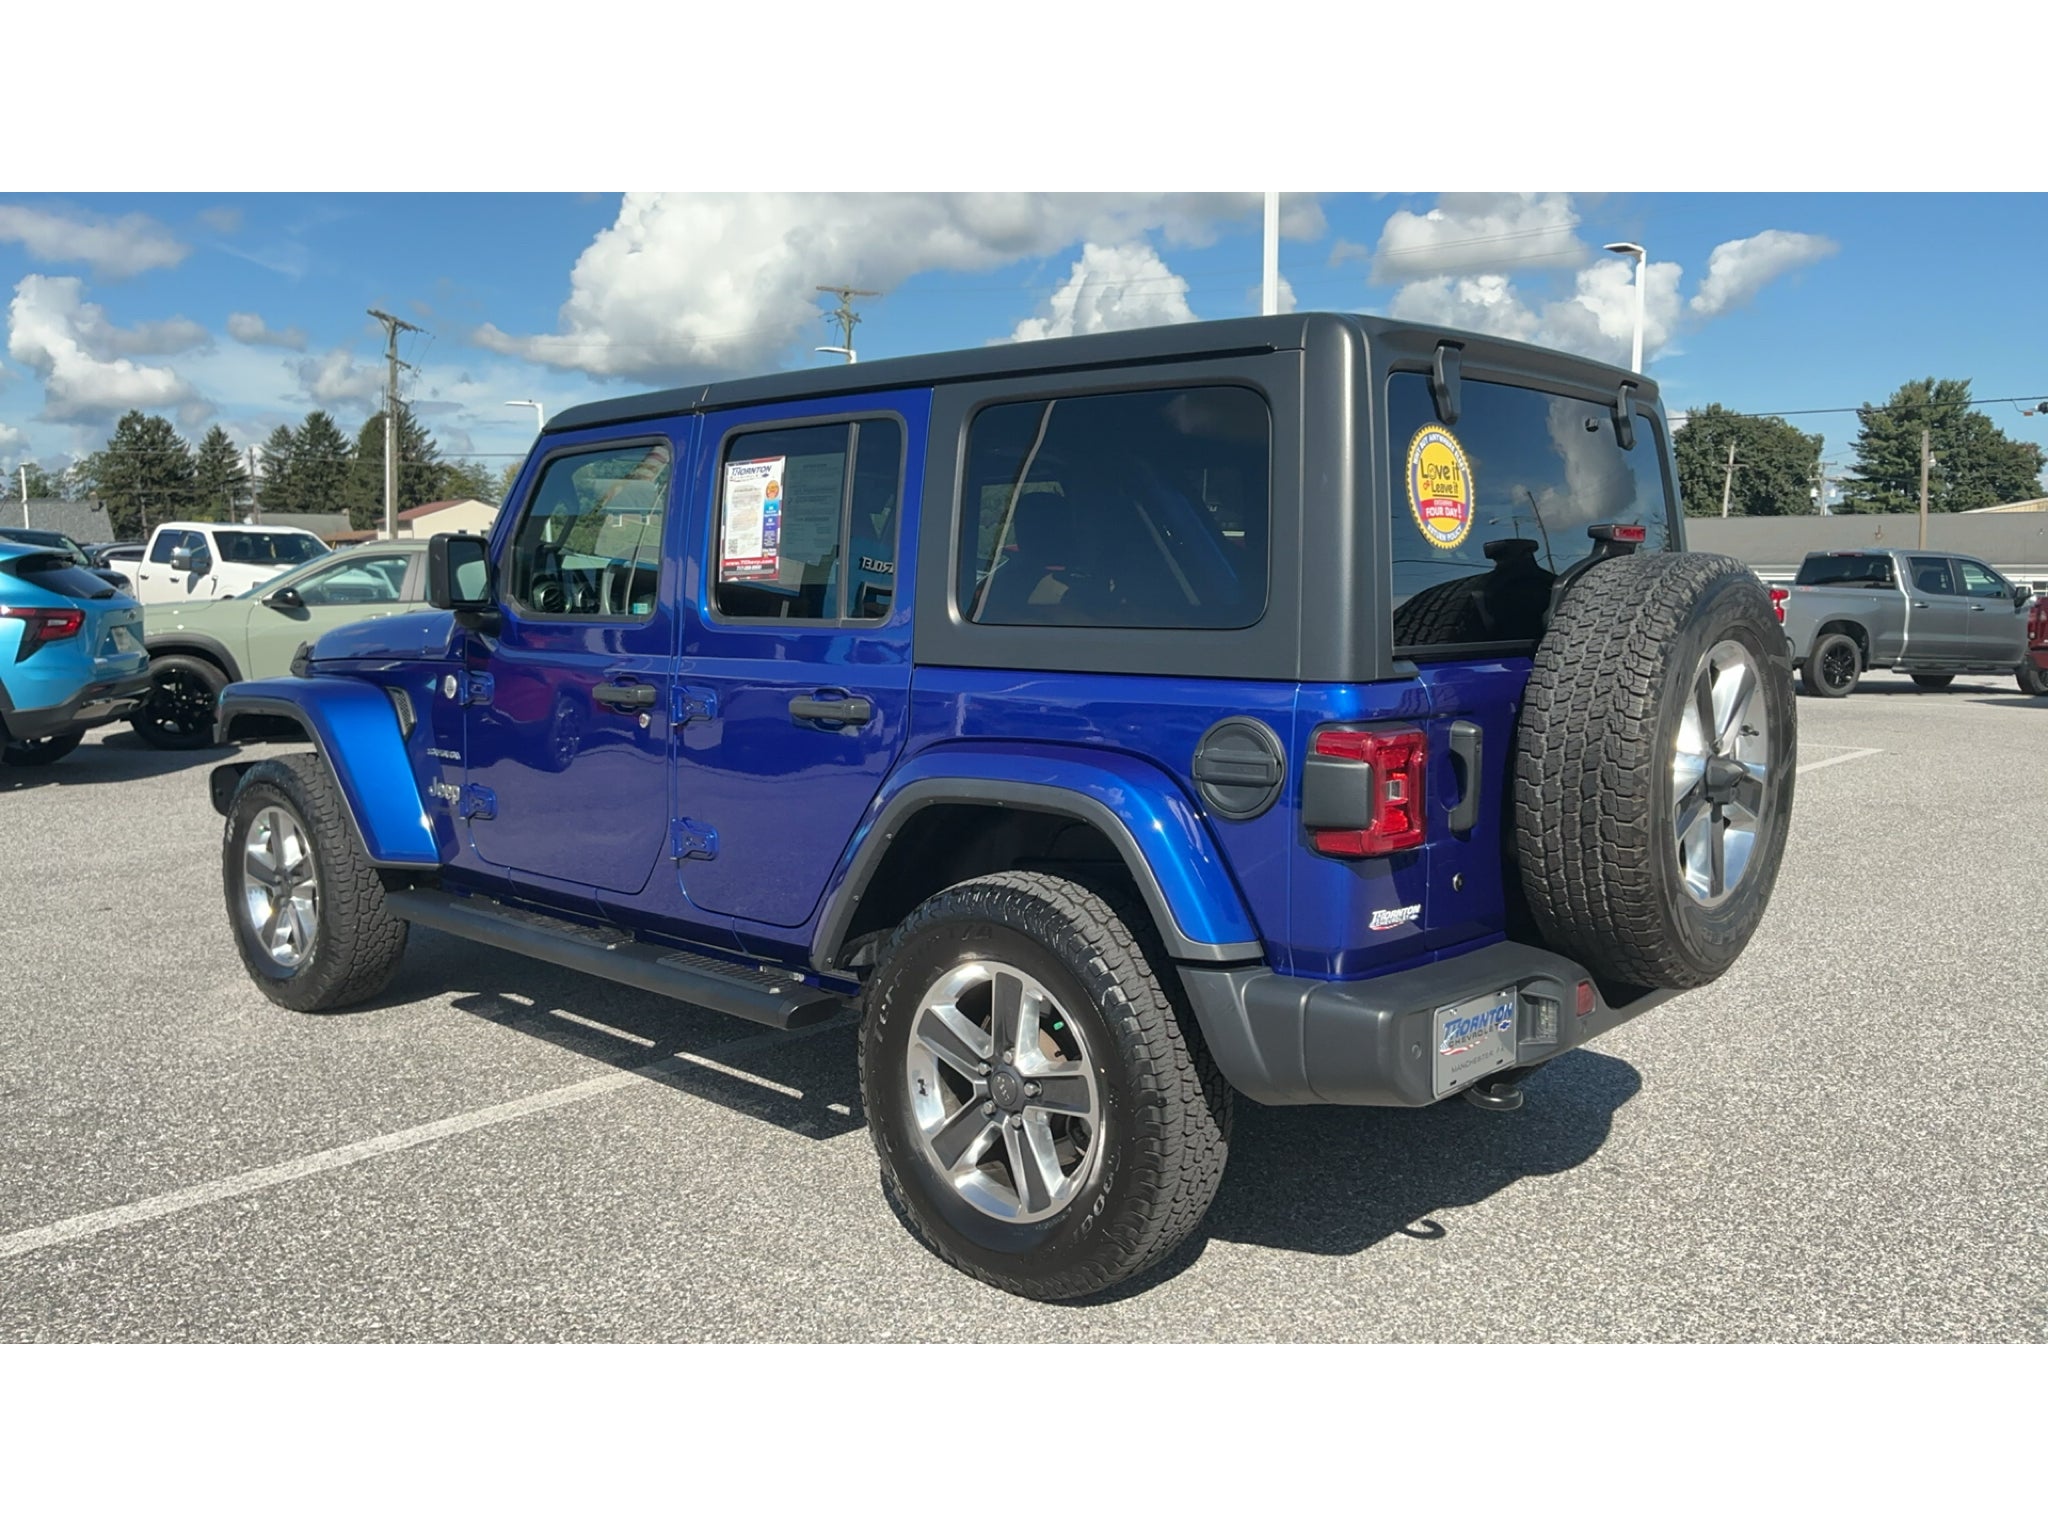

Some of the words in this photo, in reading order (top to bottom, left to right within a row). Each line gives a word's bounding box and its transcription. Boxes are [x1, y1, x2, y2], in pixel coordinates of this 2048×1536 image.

[732, 465, 772, 476] THORNTON
[1420, 458, 1451, 480] Love
[1452, 461, 1460, 481] it
[1431, 481, 1453, 493] Leave
[1426, 506, 1444, 518] FOUR
[428, 776, 460, 805] Jeep
[1369, 903, 1421, 926] THORNTON
[1443, 1002, 1513, 1040] THORNTON
[1448, 1023, 1500, 1048] CHEVROLET
